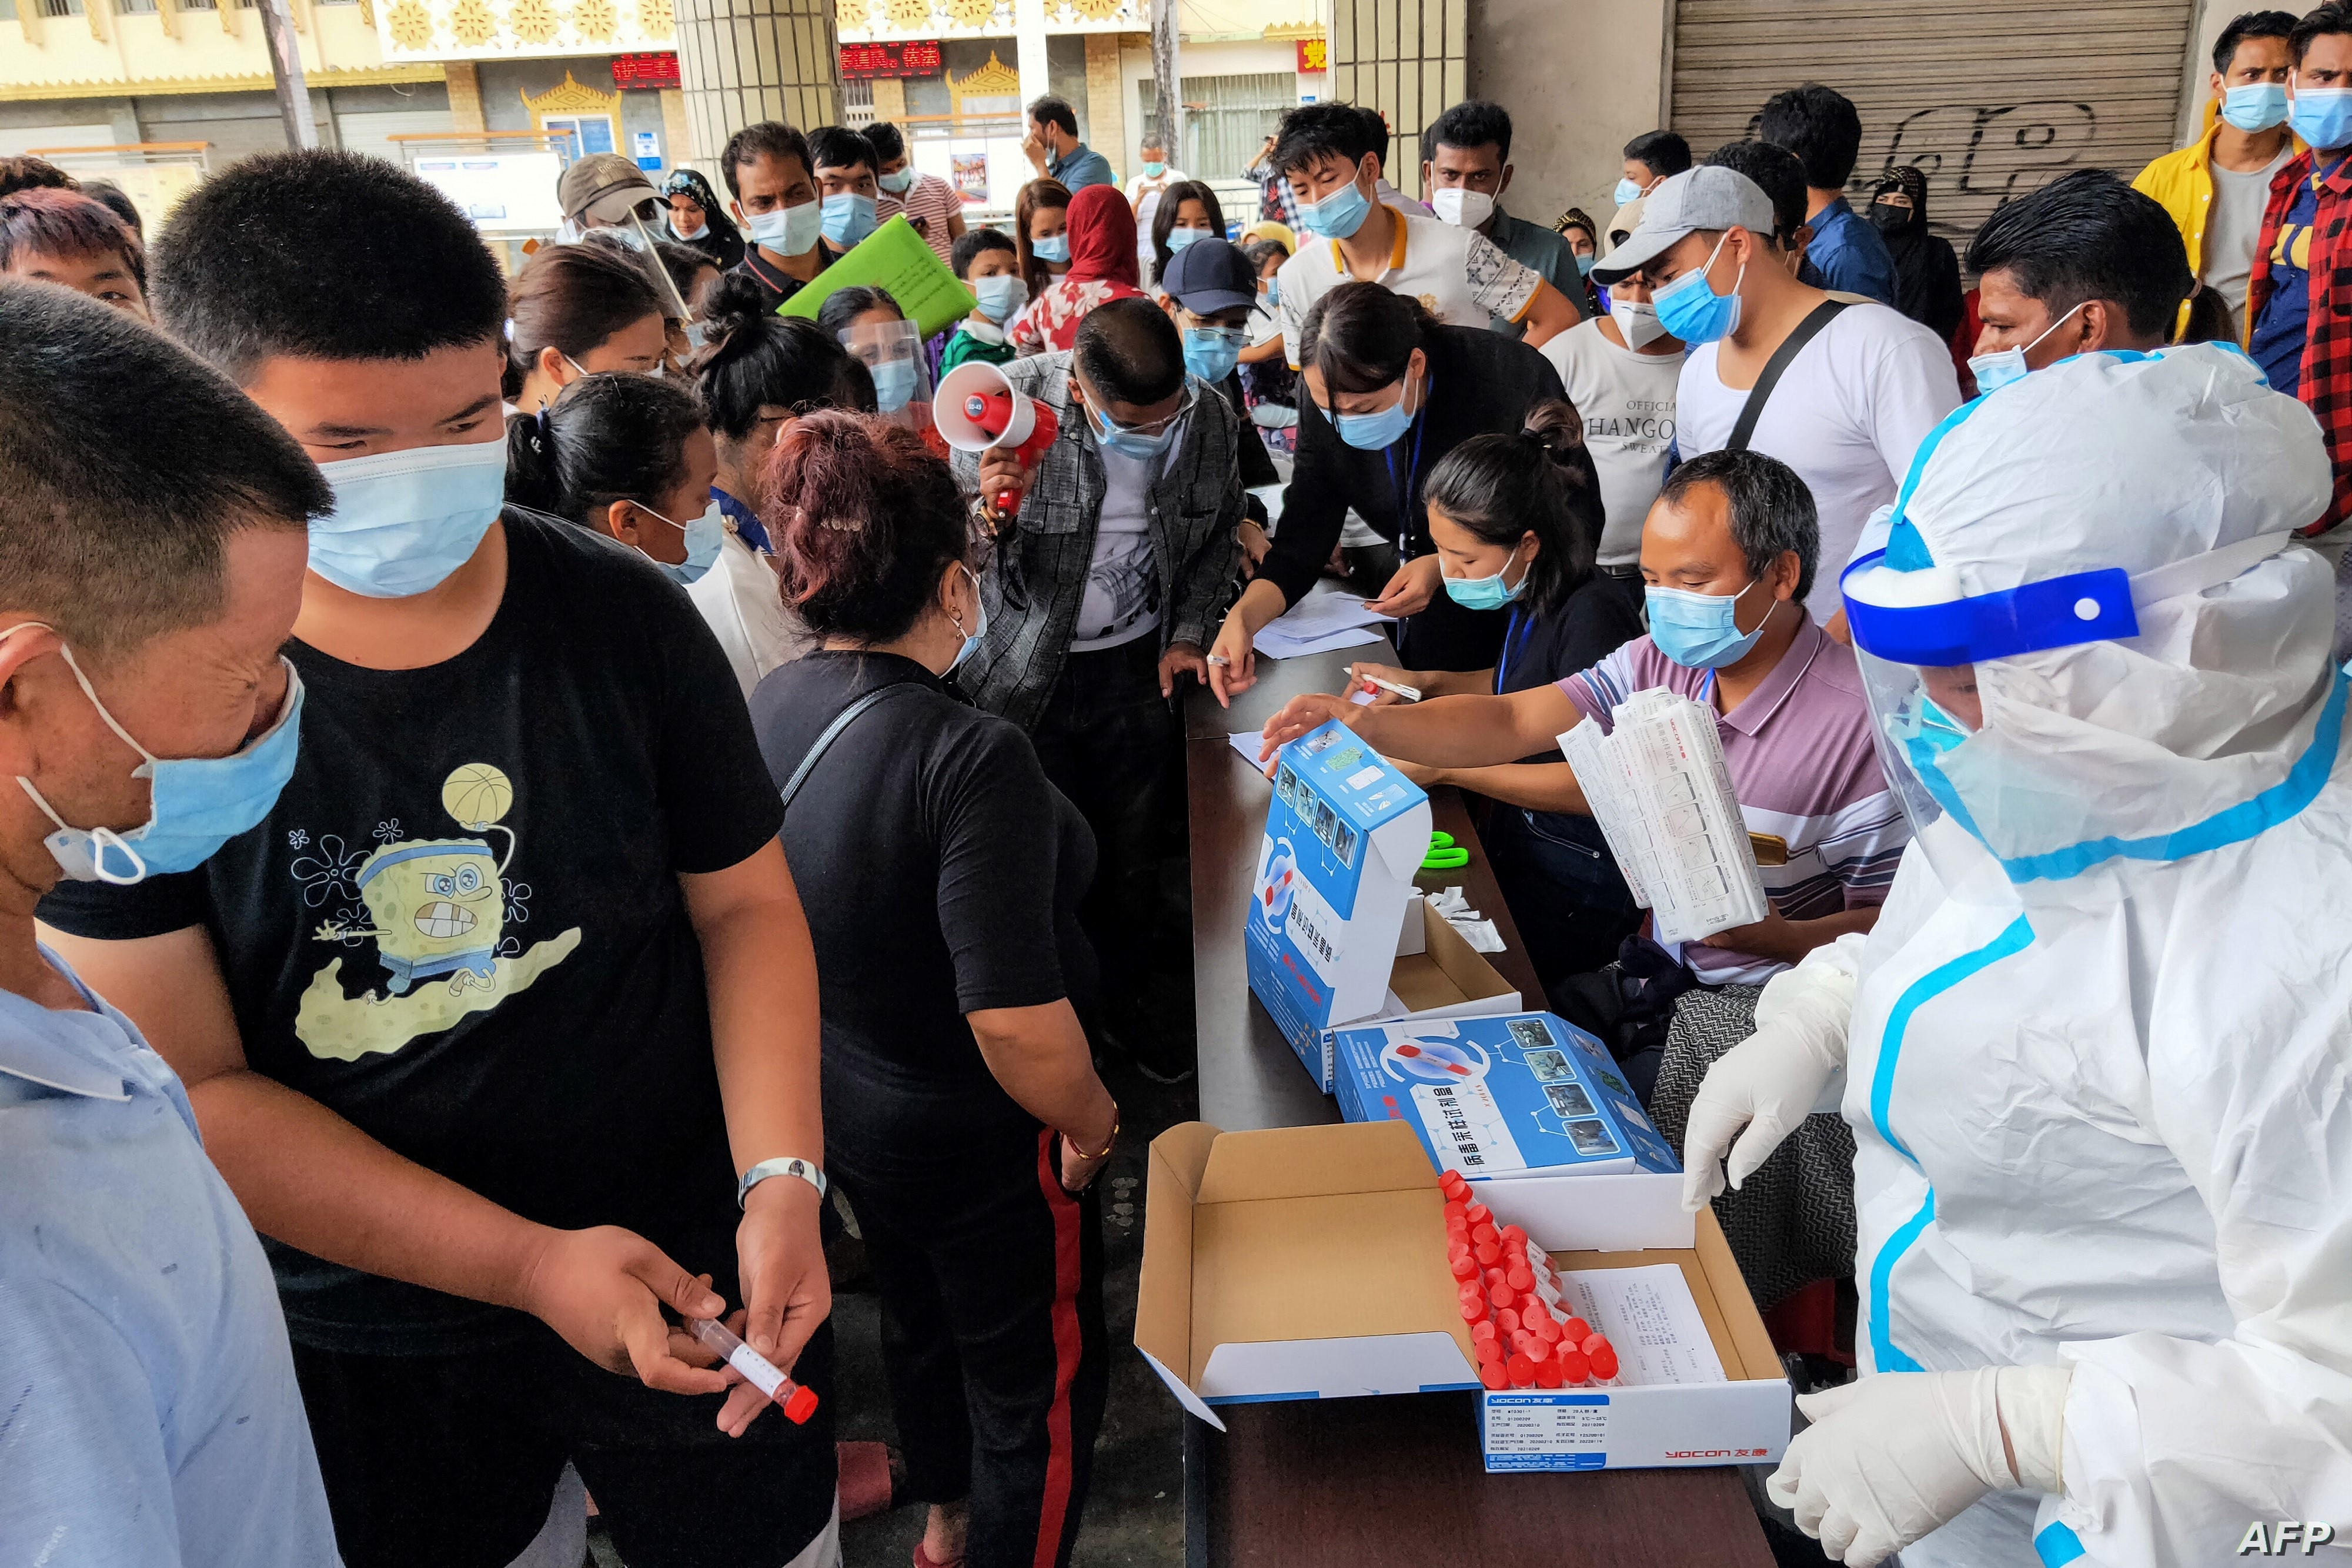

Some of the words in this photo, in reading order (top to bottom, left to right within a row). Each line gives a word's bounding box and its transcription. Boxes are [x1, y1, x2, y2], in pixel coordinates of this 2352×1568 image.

[1304, 40, 1327, 69] 党
[1433, 1086, 1485, 1166] 病毒采样试剂盒
[1734, 1448, 1768, 1457] 友康
